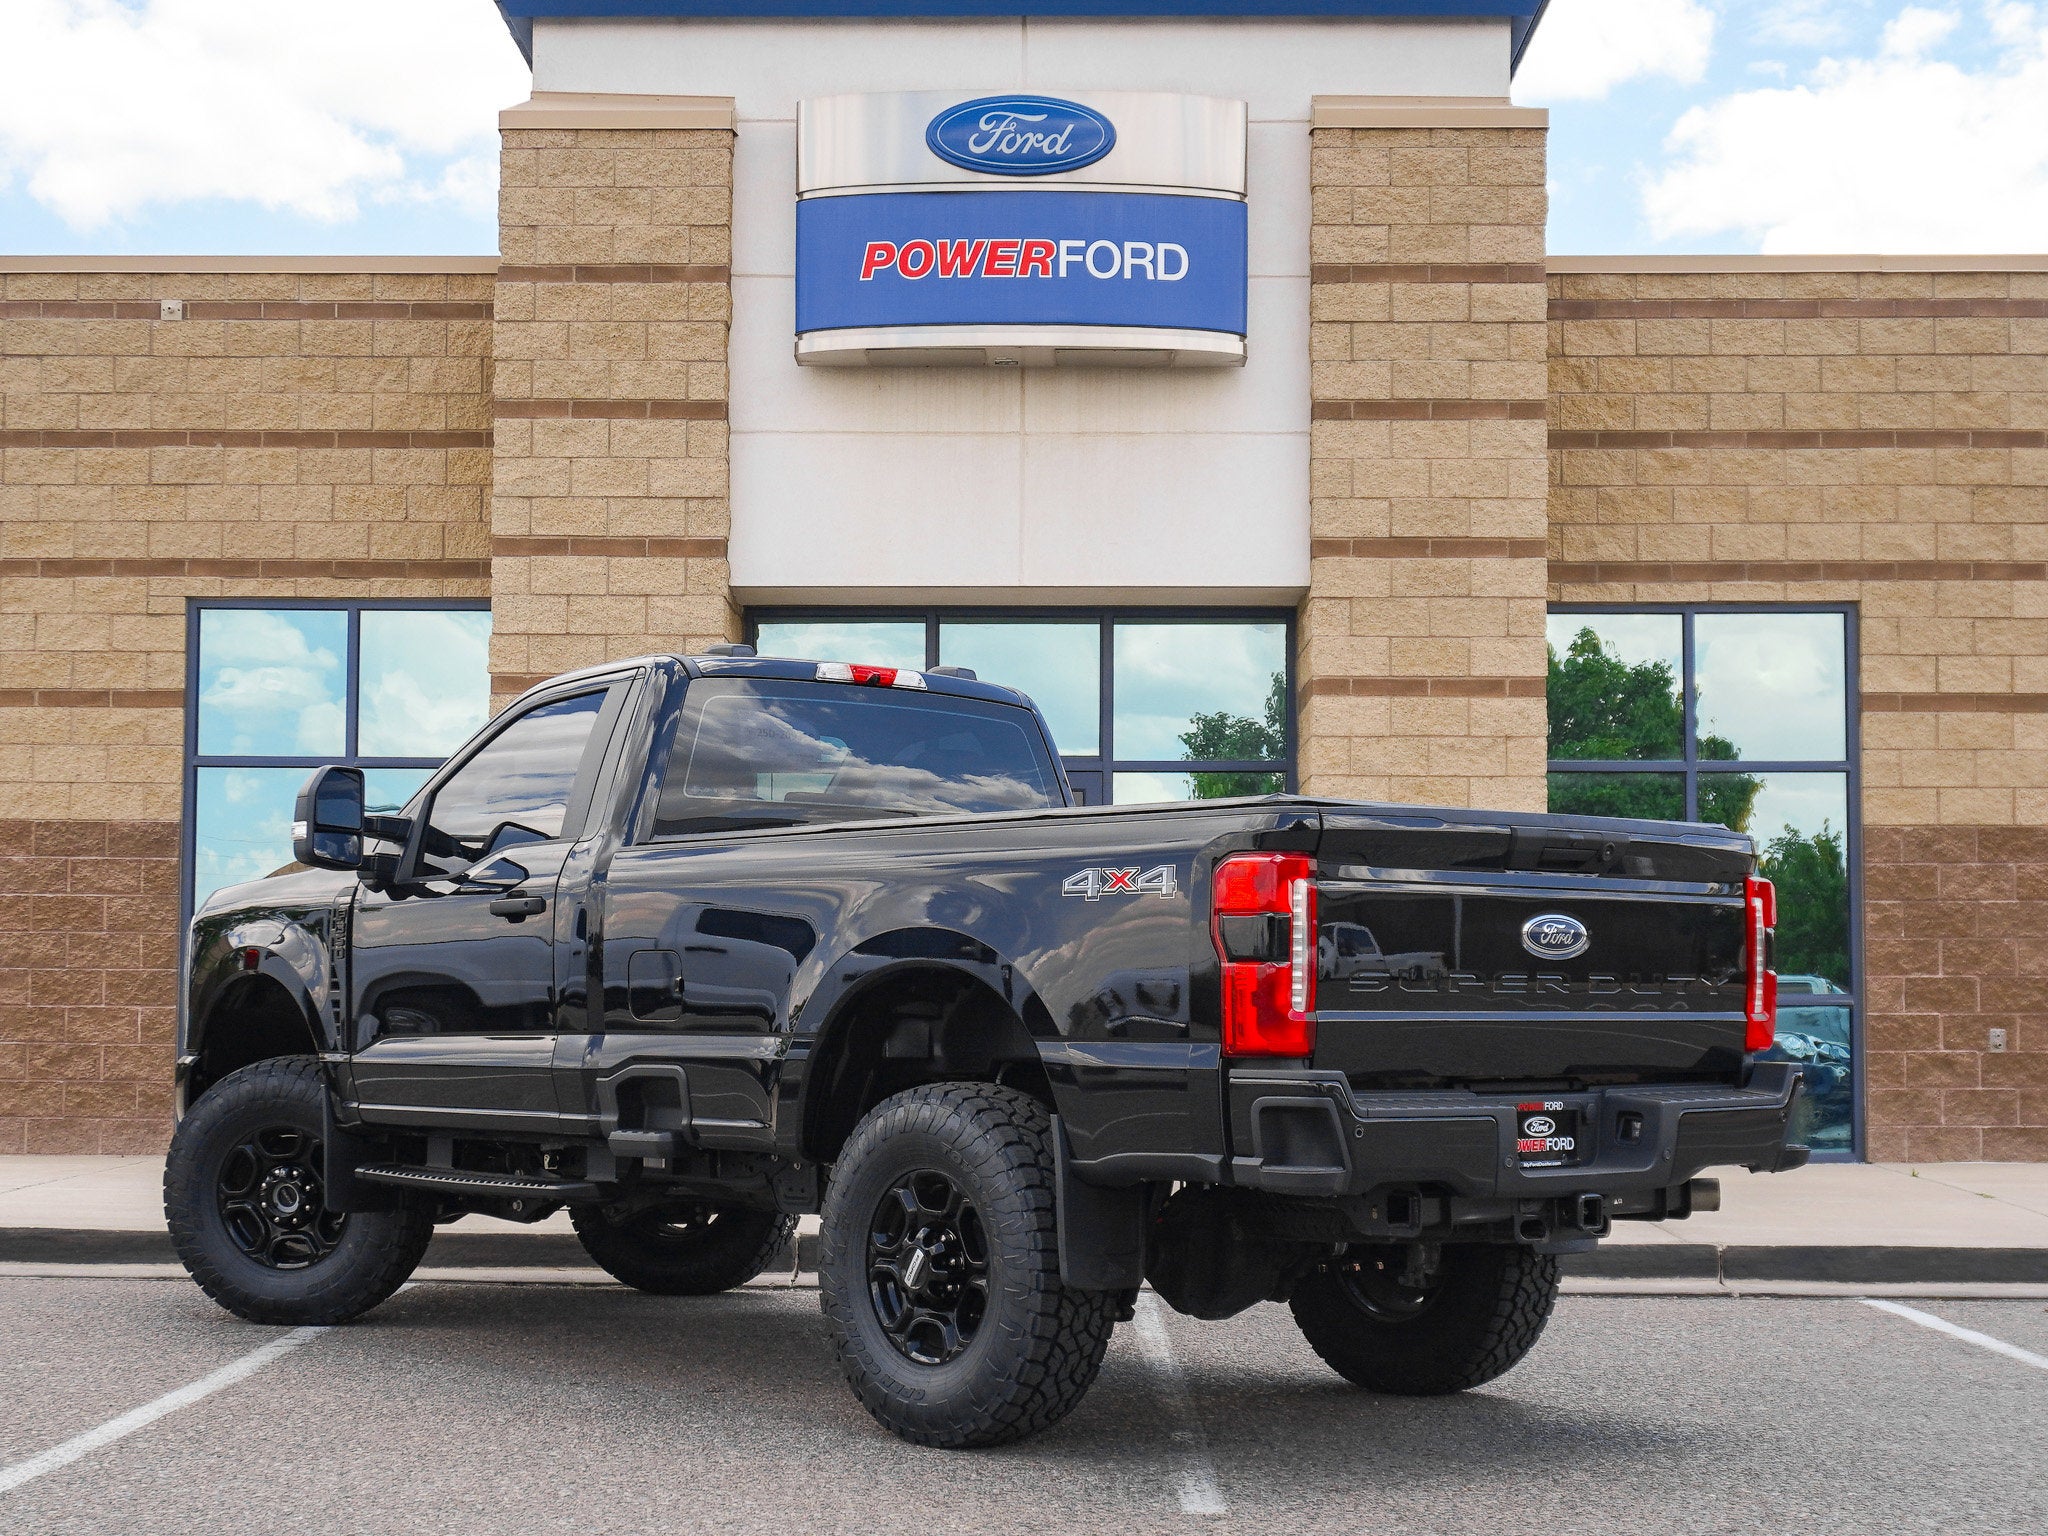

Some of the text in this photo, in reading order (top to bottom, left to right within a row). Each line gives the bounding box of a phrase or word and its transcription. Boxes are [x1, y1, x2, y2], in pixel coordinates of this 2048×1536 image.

[968, 111, 1075, 156] Ford
[859, 237, 1190, 282] POWERFORD
[1540, 922, 1575, 945] Ford
[1349, 972, 1730, 996] SUPER DUTY
[1530, 1121, 1549, 1132] Ford
[1517, 1137, 1575, 1153] OWERFORD
